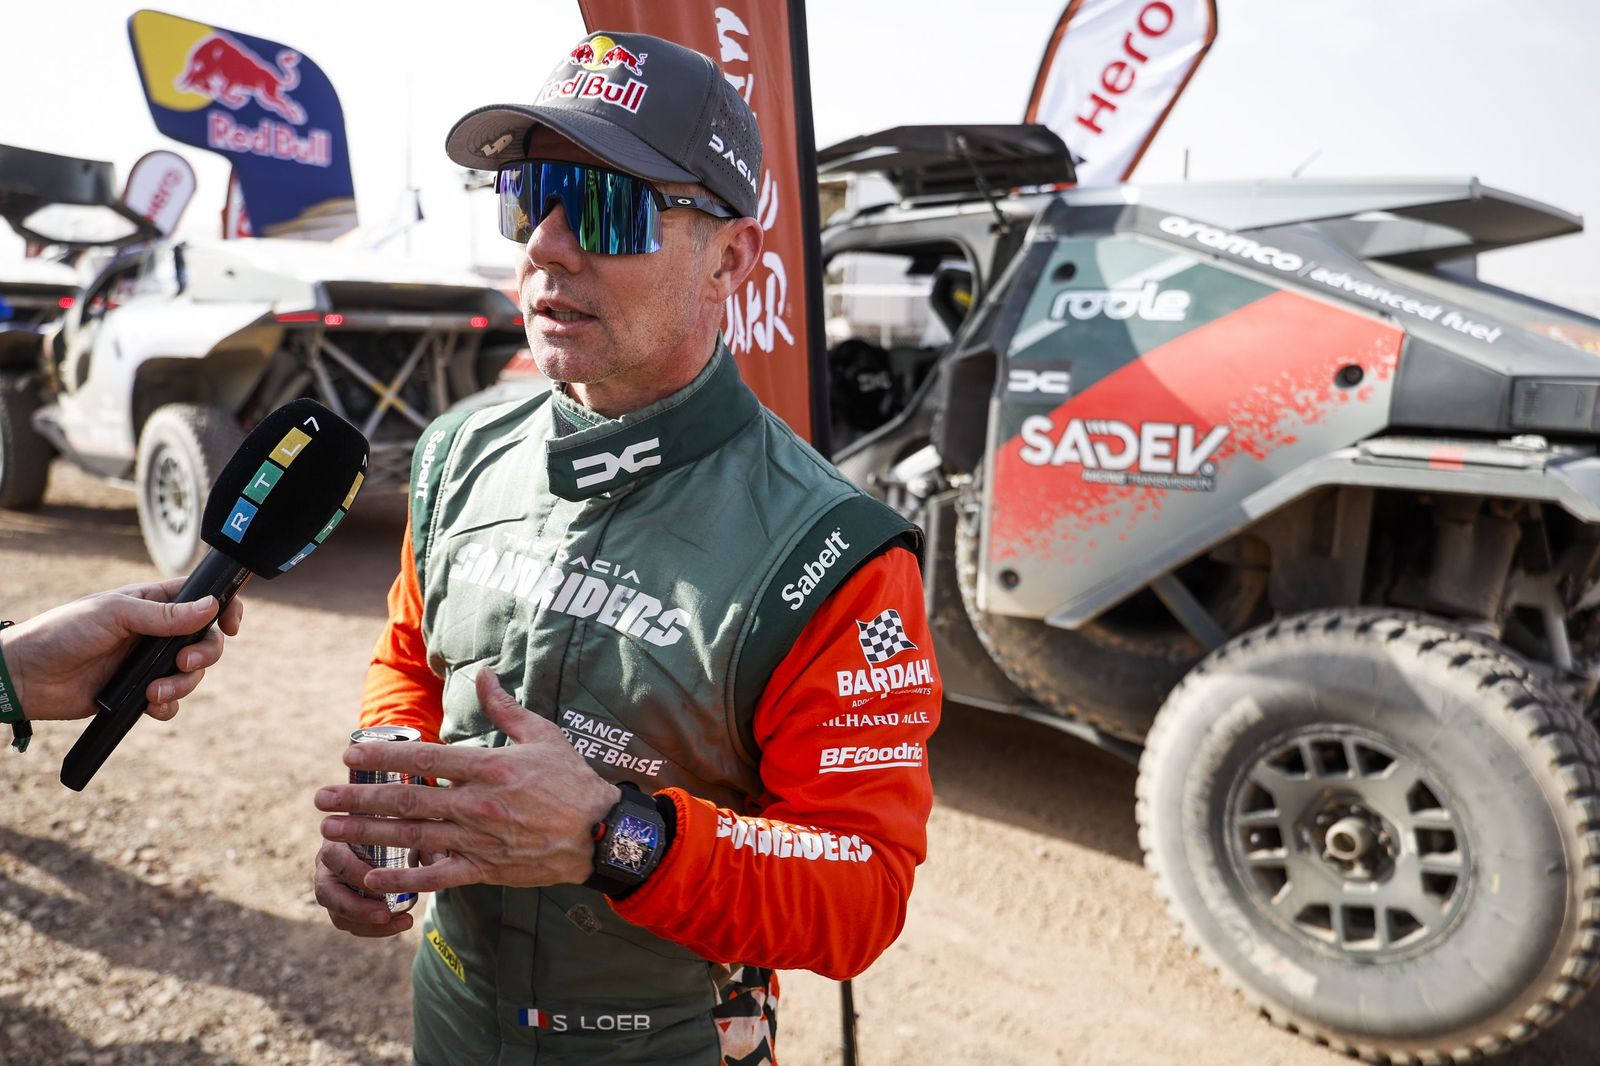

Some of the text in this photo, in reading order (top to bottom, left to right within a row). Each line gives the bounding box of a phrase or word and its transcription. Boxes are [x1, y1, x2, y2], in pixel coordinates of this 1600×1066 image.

[579, 73, 648, 114] Bull
[1075, 2, 1174, 136] Hero
[207, 111, 331, 167] Red Bull
[708, 134, 757, 194] DACIA
[1158, 216, 1303, 271] aramco
[1310, 267, 1443, 321] advanced
[1441, 311, 1502, 344] fuel
[415, 430, 446, 504] Sabelt
[1018, 414, 1230, 475] SADEV
[781, 530, 850, 611] Sabelt
[563, 709, 634, 746] FRANCE
[820, 742, 923, 767] BFGoodric
[553, 1014, 651, 1032] S LOEB
